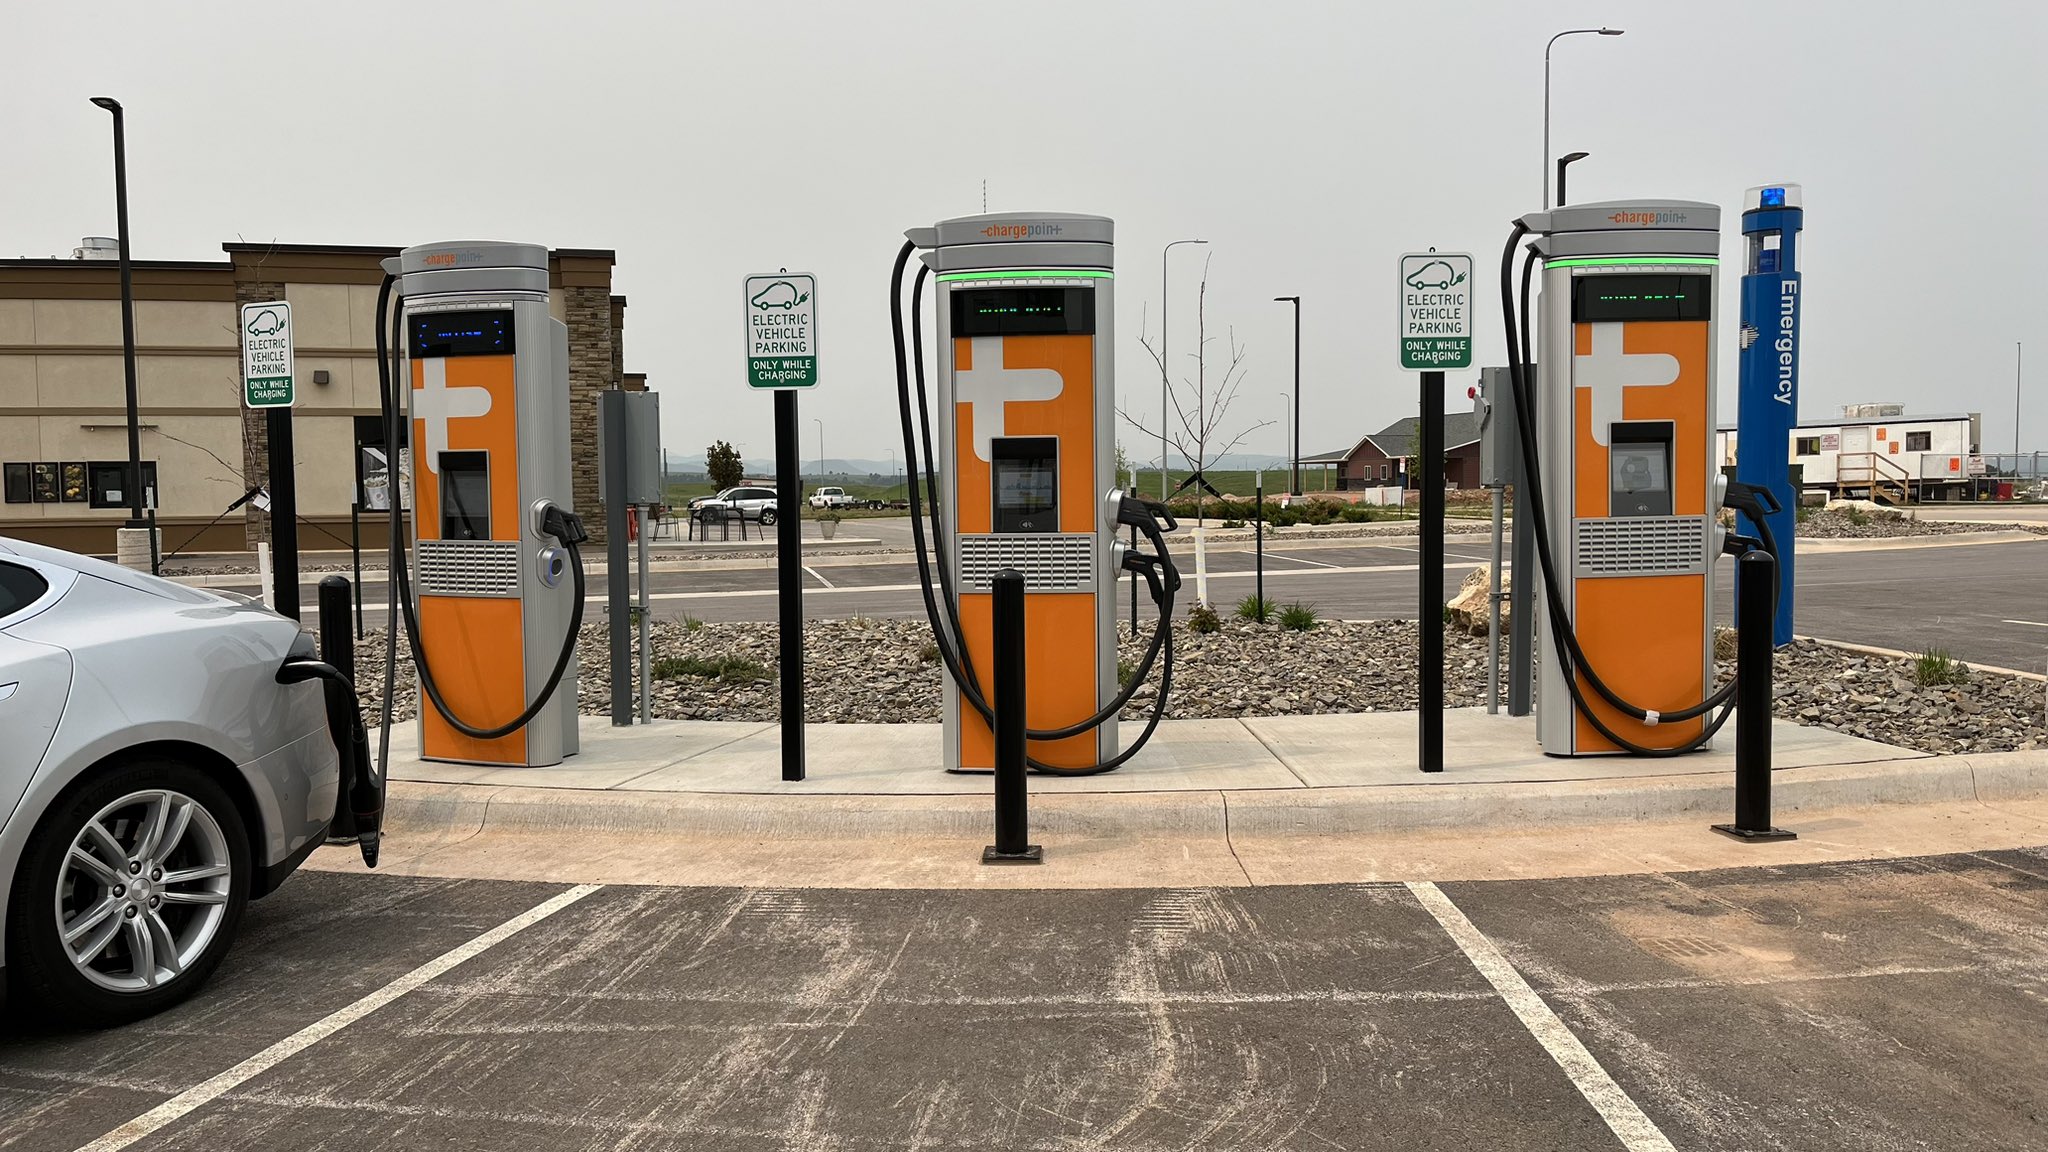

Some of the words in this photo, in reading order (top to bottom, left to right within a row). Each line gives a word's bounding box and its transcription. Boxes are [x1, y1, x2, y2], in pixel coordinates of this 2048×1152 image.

[1407, 293, 1464, 306] ELECTRIC
[752, 313, 808, 326] ELECTRIC
[1410, 308, 1462, 320] VEHICLE
[756, 327, 806, 340] VEHICLE
[1409, 322, 1462, 334] PARKING
[248, 338, 287, 351] ELECTRIC
[755, 341, 807, 354] PARKING
[1406, 341, 1432, 351] ONLY
[1436, 340, 1466, 350] WHILE
[1773, 279, 1798, 405] Emergency
[251, 350, 285, 363] VEHICLE
[1411, 351, 1461, 361] CHARGING
[251, 363, 286, 375] PARKING
[753, 360, 779, 370] ONLY
[782, 359, 812, 369] WHILE
[758, 370, 807, 380] CHARGING
[249, 381, 268, 390] ONLY
[269, 379, 290, 389] WHILE
[253, 389, 287, 399] CHARGING
